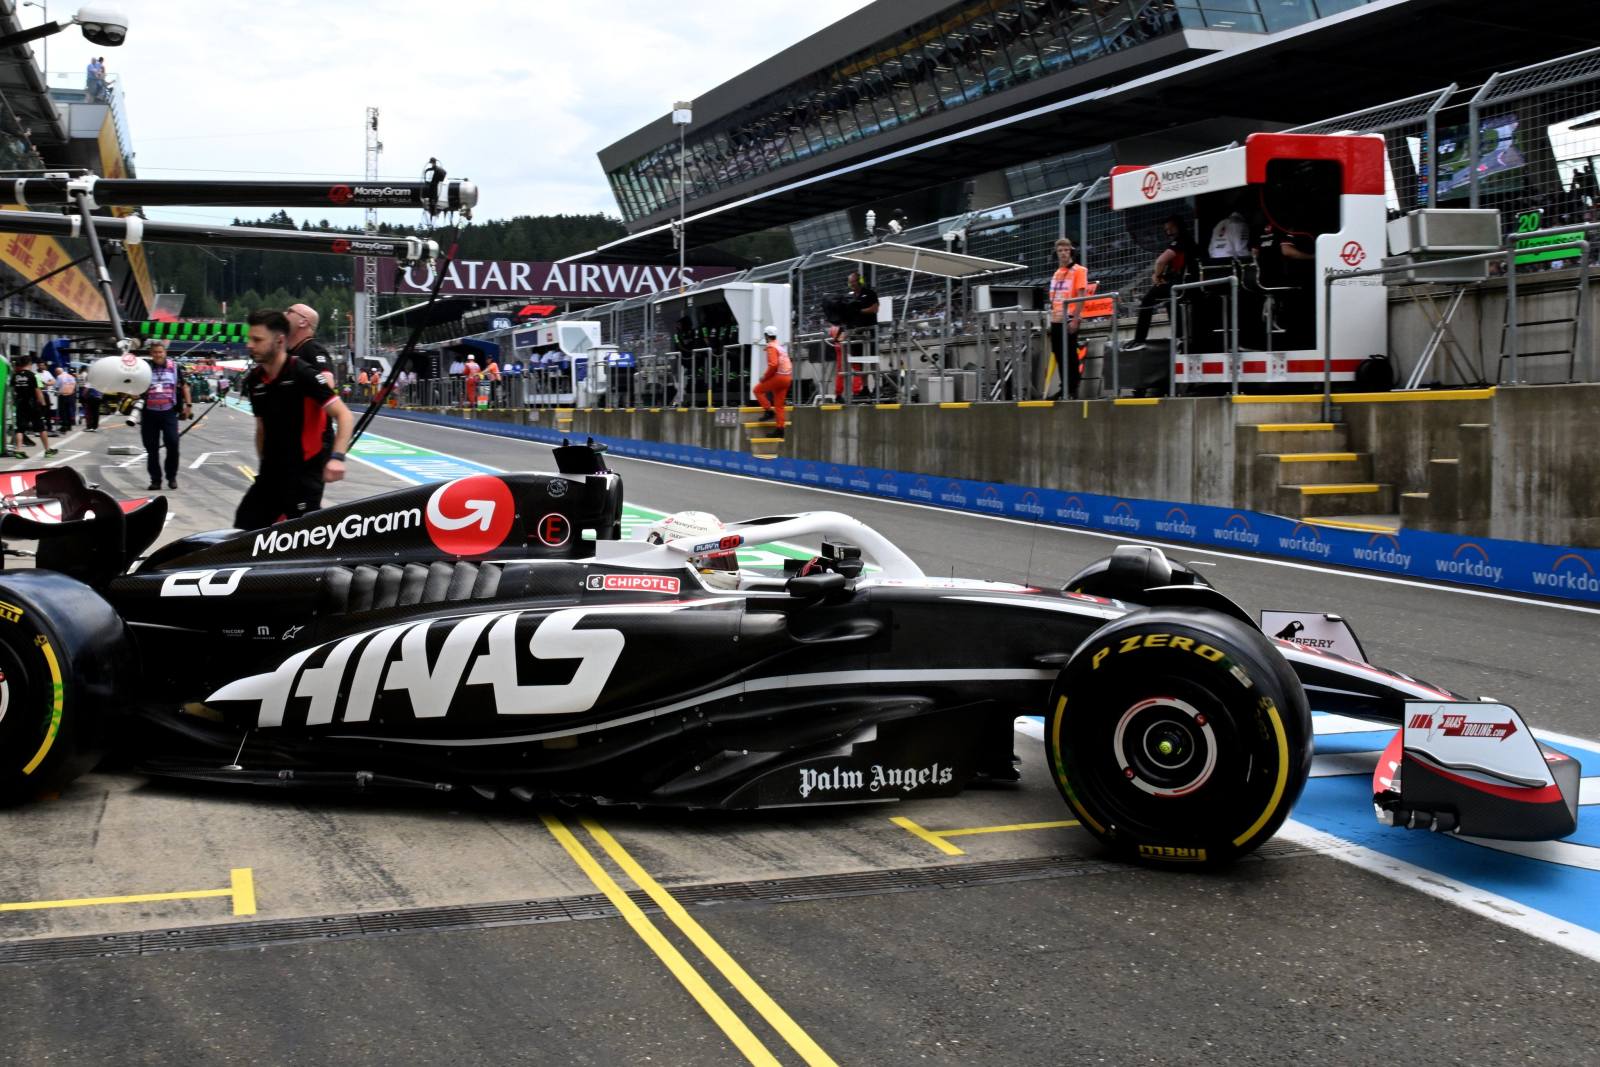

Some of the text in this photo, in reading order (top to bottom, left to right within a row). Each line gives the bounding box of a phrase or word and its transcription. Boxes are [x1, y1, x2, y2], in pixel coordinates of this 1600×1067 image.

[1161, 165, 1209, 182] MoneyGram
[353, 187, 411, 197] MoneyGram
[1519, 212, 1540, 233] 20
[351, 242, 394, 250] MoneyGram
[403, 261, 695, 293] QATAR AIRWAYS
[492, 319, 512, 329] FIA
[977, 497, 1003, 511] workday
[1014, 502, 1044, 517] workday
[1056, 507, 1090, 523] workday
[1103, 513, 1140, 530] workday
[252, 508, 421, 557] MoneyGram
[545, 517, 561, 543] E
[1155, 520, 1196, 537] workday
[1213, 527, 1259, 545] workday
[720, 535, 740, 549] GO
[1279, 535, 1331, 557] workday
[1353, 547, 1411, 570] workday
[1436, 557, 1502, 581] workday
[160, 567, 252, 597] 20
[607, 577, 676, 591] CHIPOTLE
[1532, 570, 1600, 592] workda
[1092, 633, 1226, 670] P ZERO
[205, 609, 626, 727] HAAS
[1443, 716, 1464, 729] HAAS
[799, 763, 953, 798] Palm Angels
[1138, 844, 1207, 862] PIRELLI
